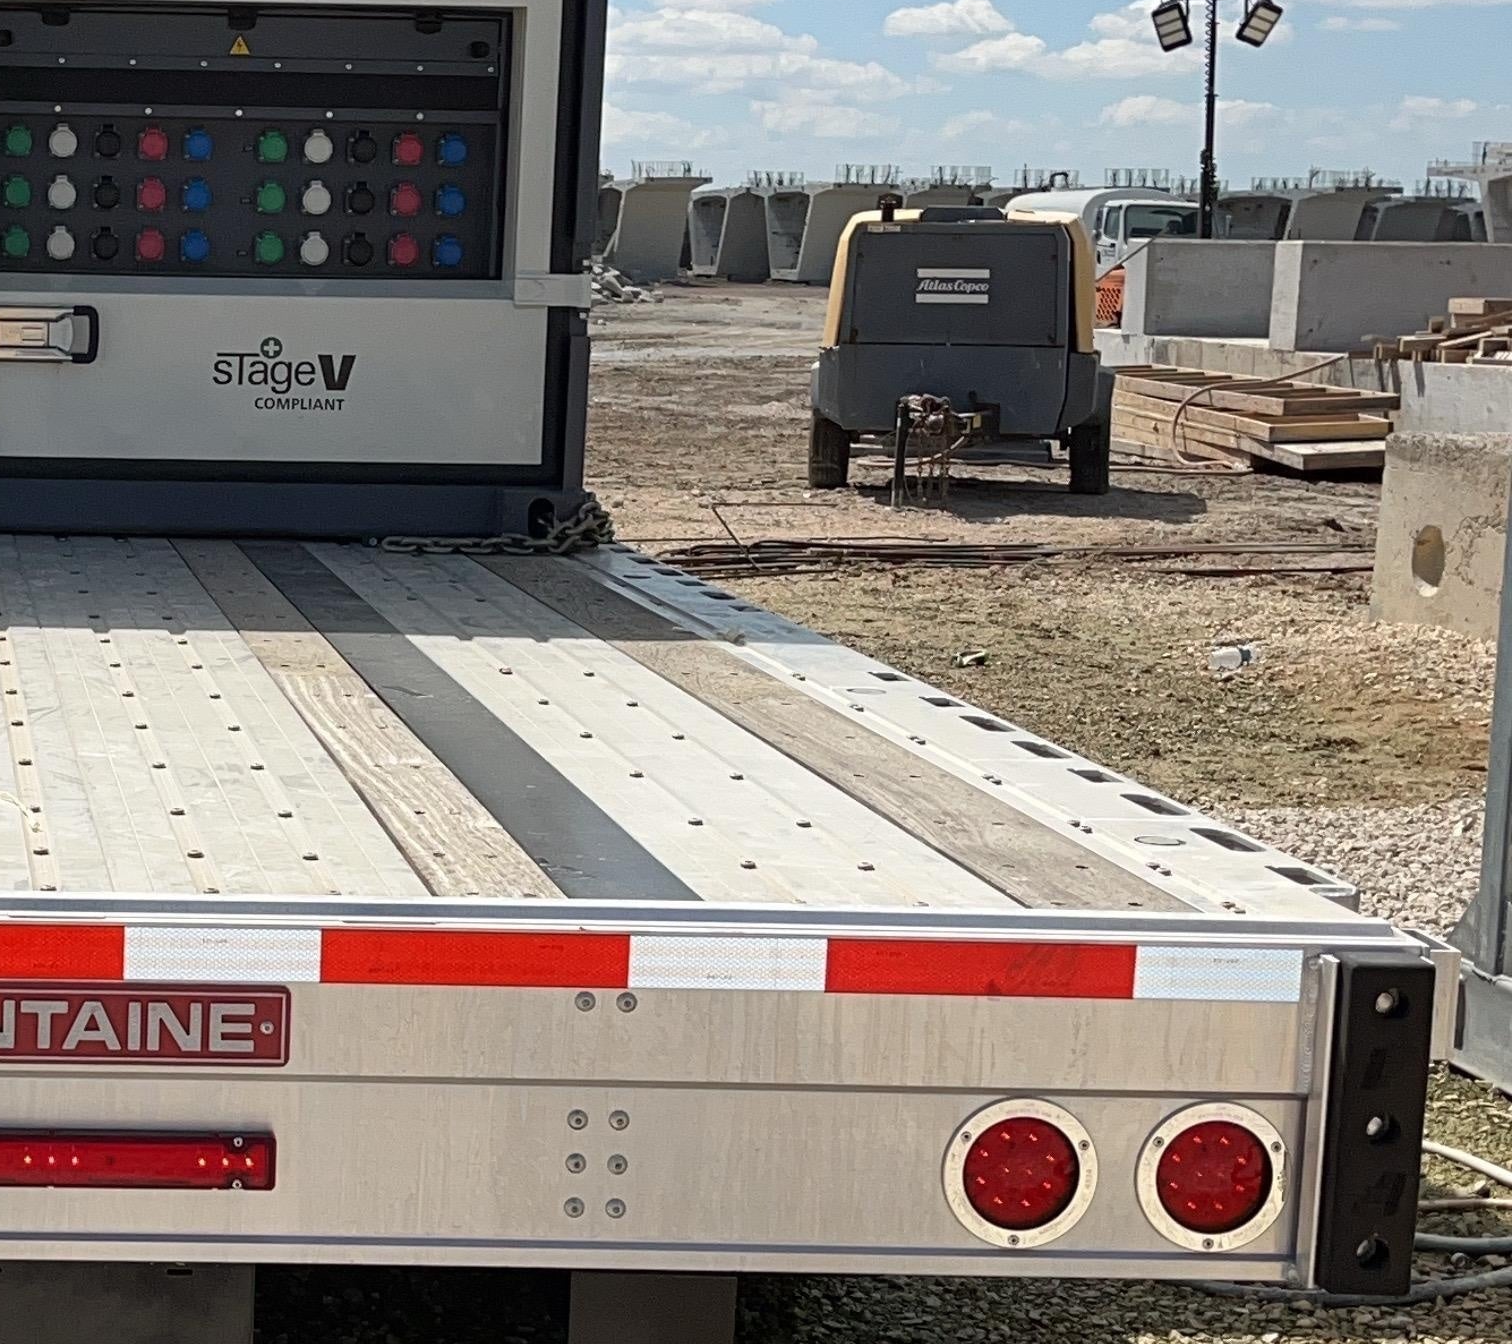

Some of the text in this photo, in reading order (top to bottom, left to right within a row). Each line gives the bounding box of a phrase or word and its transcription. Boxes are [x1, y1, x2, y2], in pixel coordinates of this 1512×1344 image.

[916, 278, 990, 294] Atlas Copco
[254, 397, 345, 411] COMPLIANT
